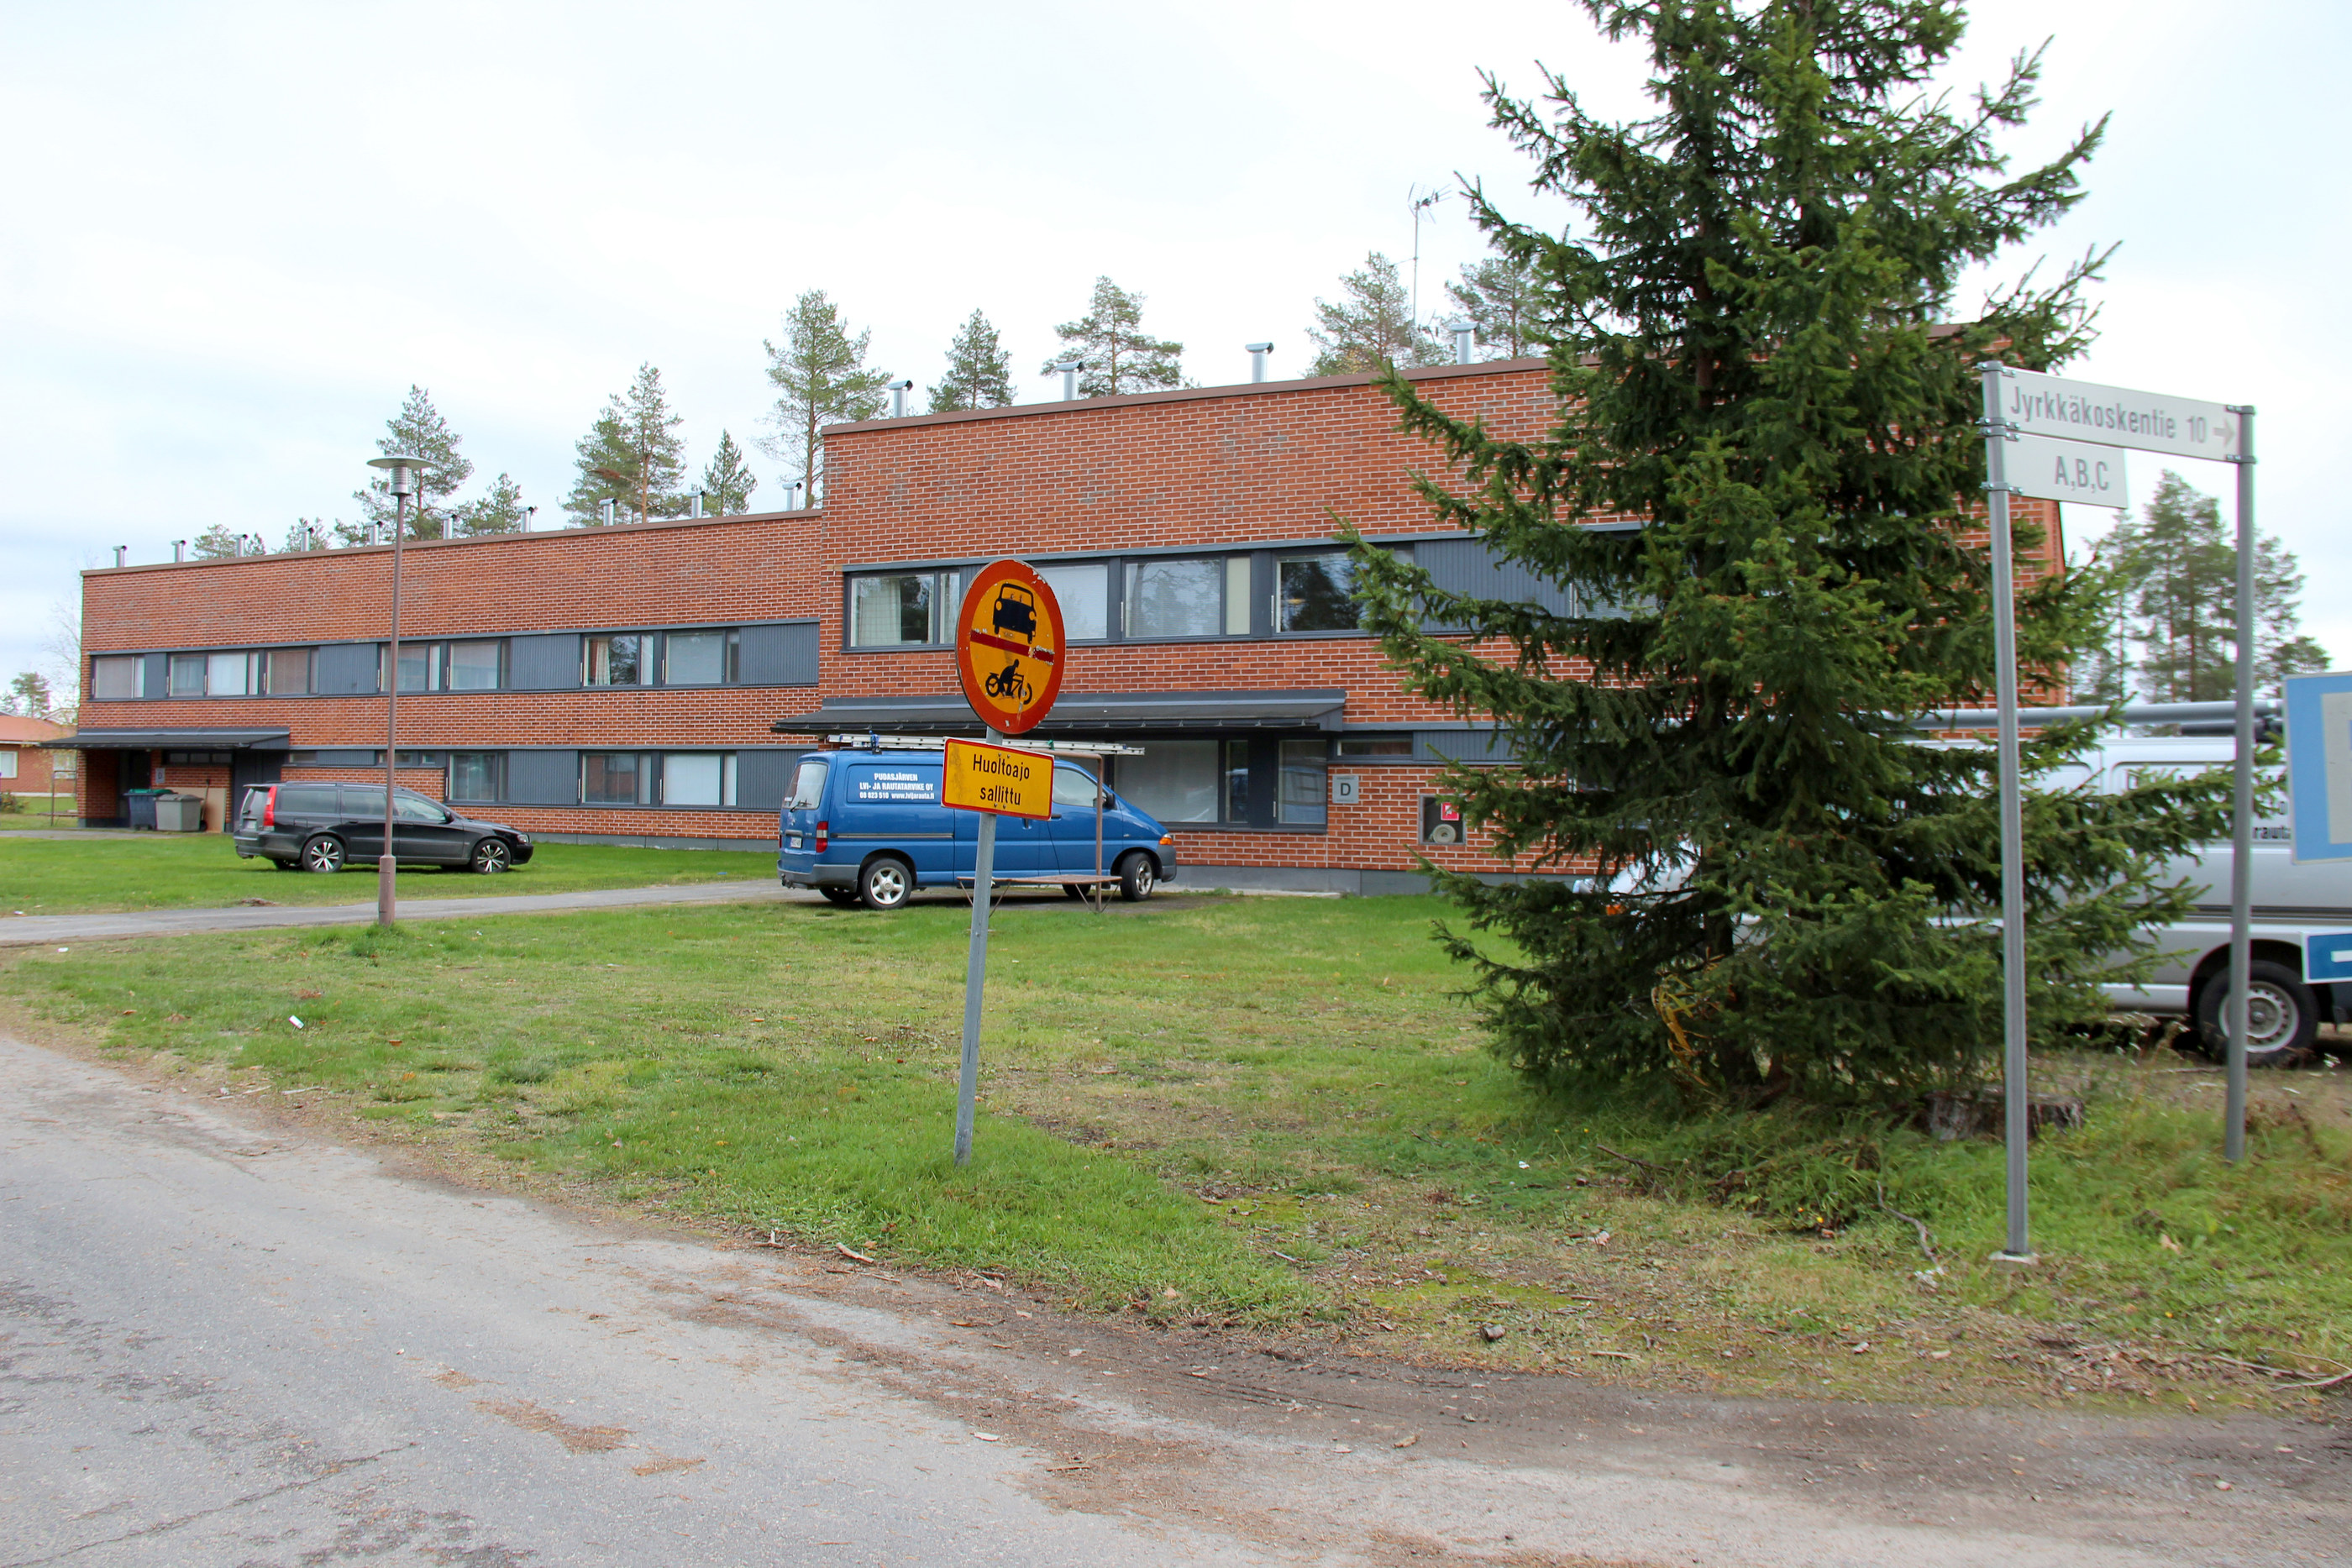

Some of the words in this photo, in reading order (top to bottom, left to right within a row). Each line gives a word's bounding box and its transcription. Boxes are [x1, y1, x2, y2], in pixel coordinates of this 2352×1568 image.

[2010, 386, 2176, 439] Jyrkkäkoskentie
[2187, 416, 2208, 443] 10
[2054, 455, 2109, 493] A,B,C
[874, 772, 918, 781] PUDASJÄRVEN
[973, 753, 1030, 781] Huoltoajo
[872, 782, 881, 790] JA
[881, 783, 925, 791] RAUTATARVIKE
[925, 783, 933, 791] OY
[979, 784, 1021, 805] sallittu
[1341, 783, 1351, 796] D
